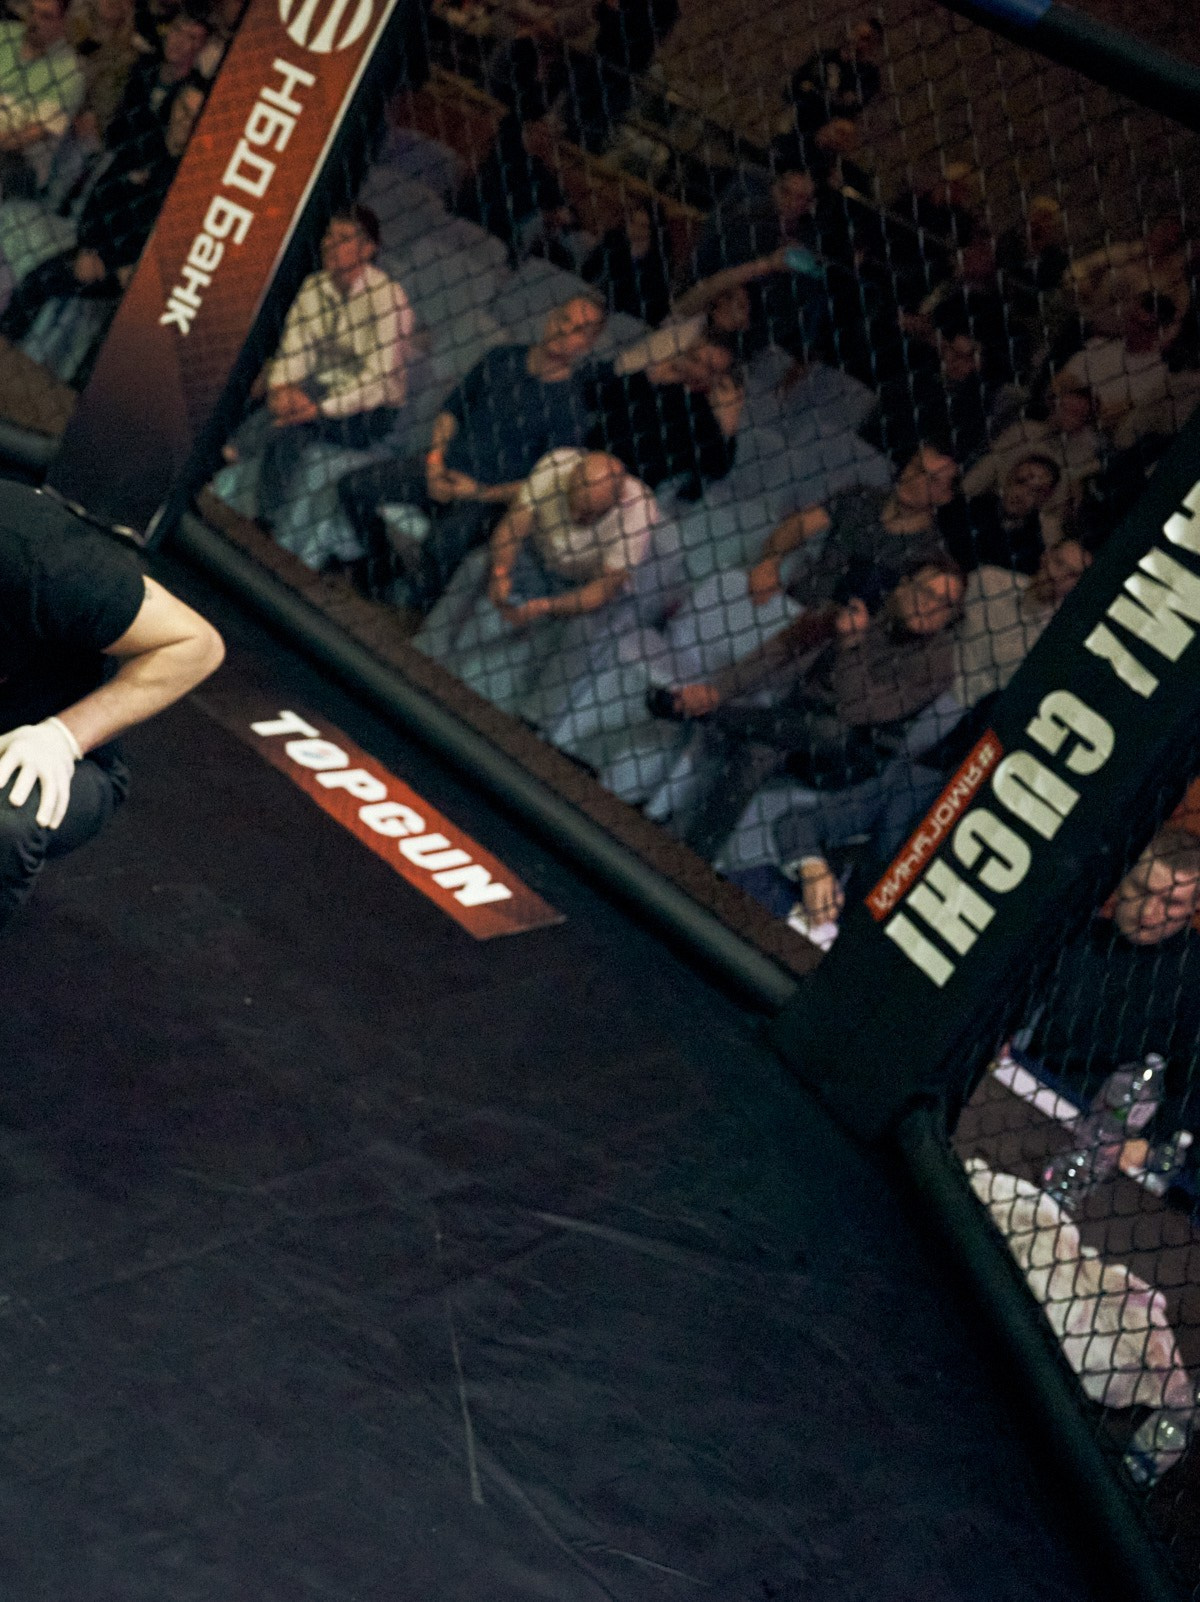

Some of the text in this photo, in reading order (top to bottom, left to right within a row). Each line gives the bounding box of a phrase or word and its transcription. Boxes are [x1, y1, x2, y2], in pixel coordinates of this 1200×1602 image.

[160, 57, 317, 335] НБД Банк
[250, 710, 513, 907] TOPGUN
